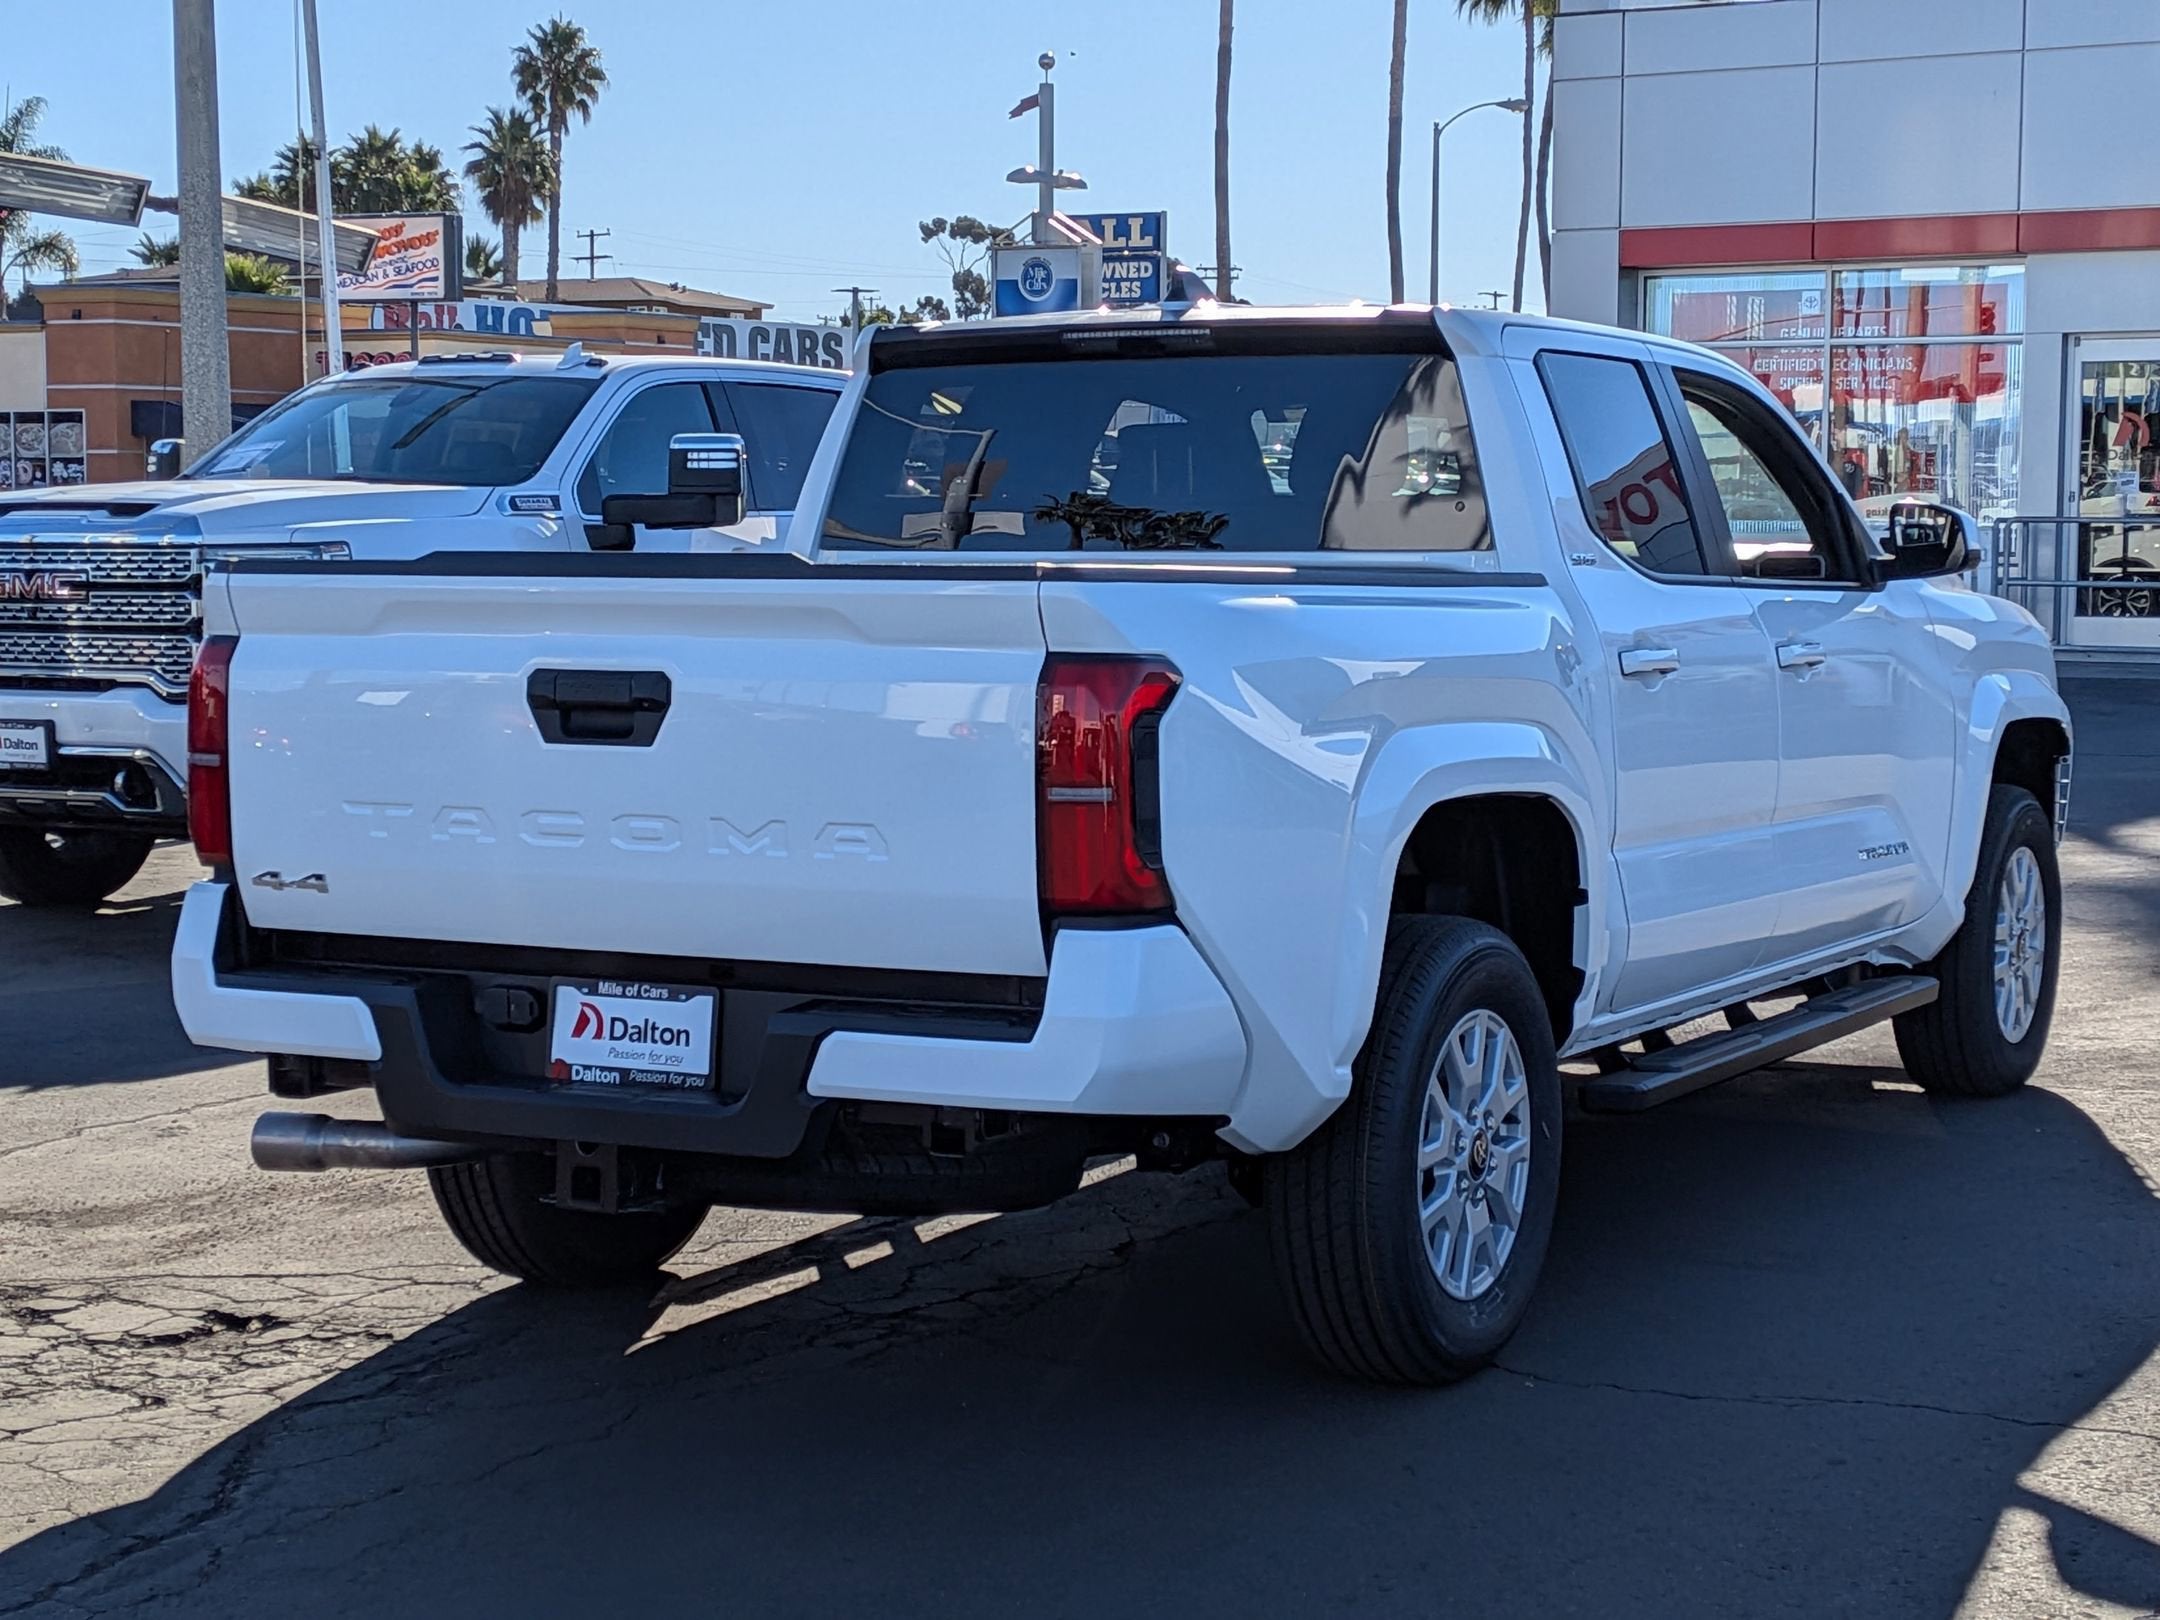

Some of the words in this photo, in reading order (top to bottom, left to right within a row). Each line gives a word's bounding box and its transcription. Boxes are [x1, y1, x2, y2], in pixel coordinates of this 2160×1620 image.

[1101, 217, 1153, 247] LL
[393, 257, 440, 277] SEAFOOD
[1102, 262, 1153, 279] WNED
[1102, 281, 1141, 298] CLES
[748, 325, 844, 369] CARS
[0, 573, 87, 599] MC
[3, 738, 38, 751] Dalton
[342, 801, 889, 862] TACOMA
[598, 982, 623, 996] Mile
[625, 984, 639, 996] of
[640, 985, 669, 999] Cars
[609, 1017, 690, 1047] Dalton
[607, 1047, 646, 1060] Passion
[648, 1052, 664, 1064] for
[664, 1055, 684, 1064] you
[571, 1065, 620, 1084] Dalton
[628, 1070, 667, 1084] Passion
[668, 1073, 683, 1085] for
[684, 1076, 705, 1088] you
